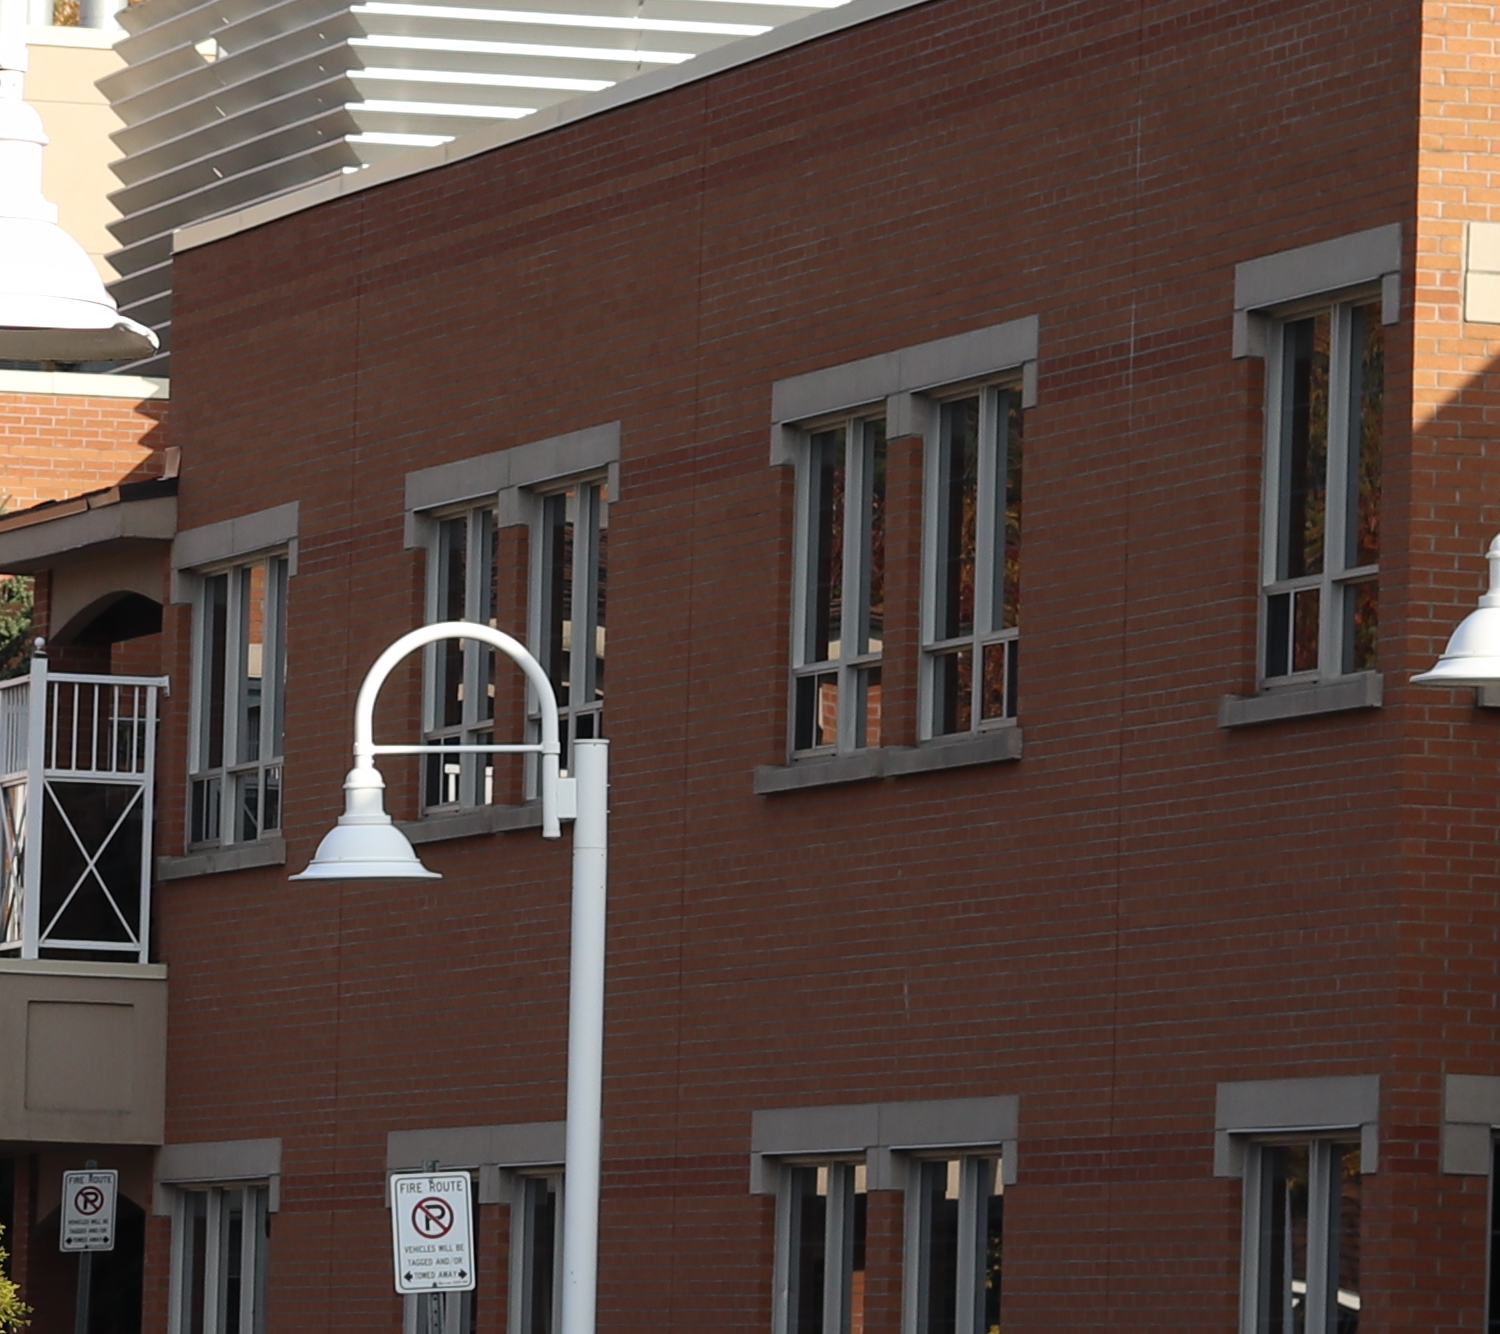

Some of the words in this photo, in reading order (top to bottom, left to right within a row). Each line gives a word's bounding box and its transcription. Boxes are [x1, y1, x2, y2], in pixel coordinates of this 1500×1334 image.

[68, 1176, 85, 1184] FIRE
[89, 1176, 112, 1184] ROUTE
[400, 1182, 423, 1193] FIRE
[429, 1180, 463, 1192] ROUTE
[405, 1244, 436, 1254] VEHICLES
[439, 1244, 453, 1252] WILL
[456, 1243, 465, 1252] BE
[407, 1258, 433, 1267] TAGGED
